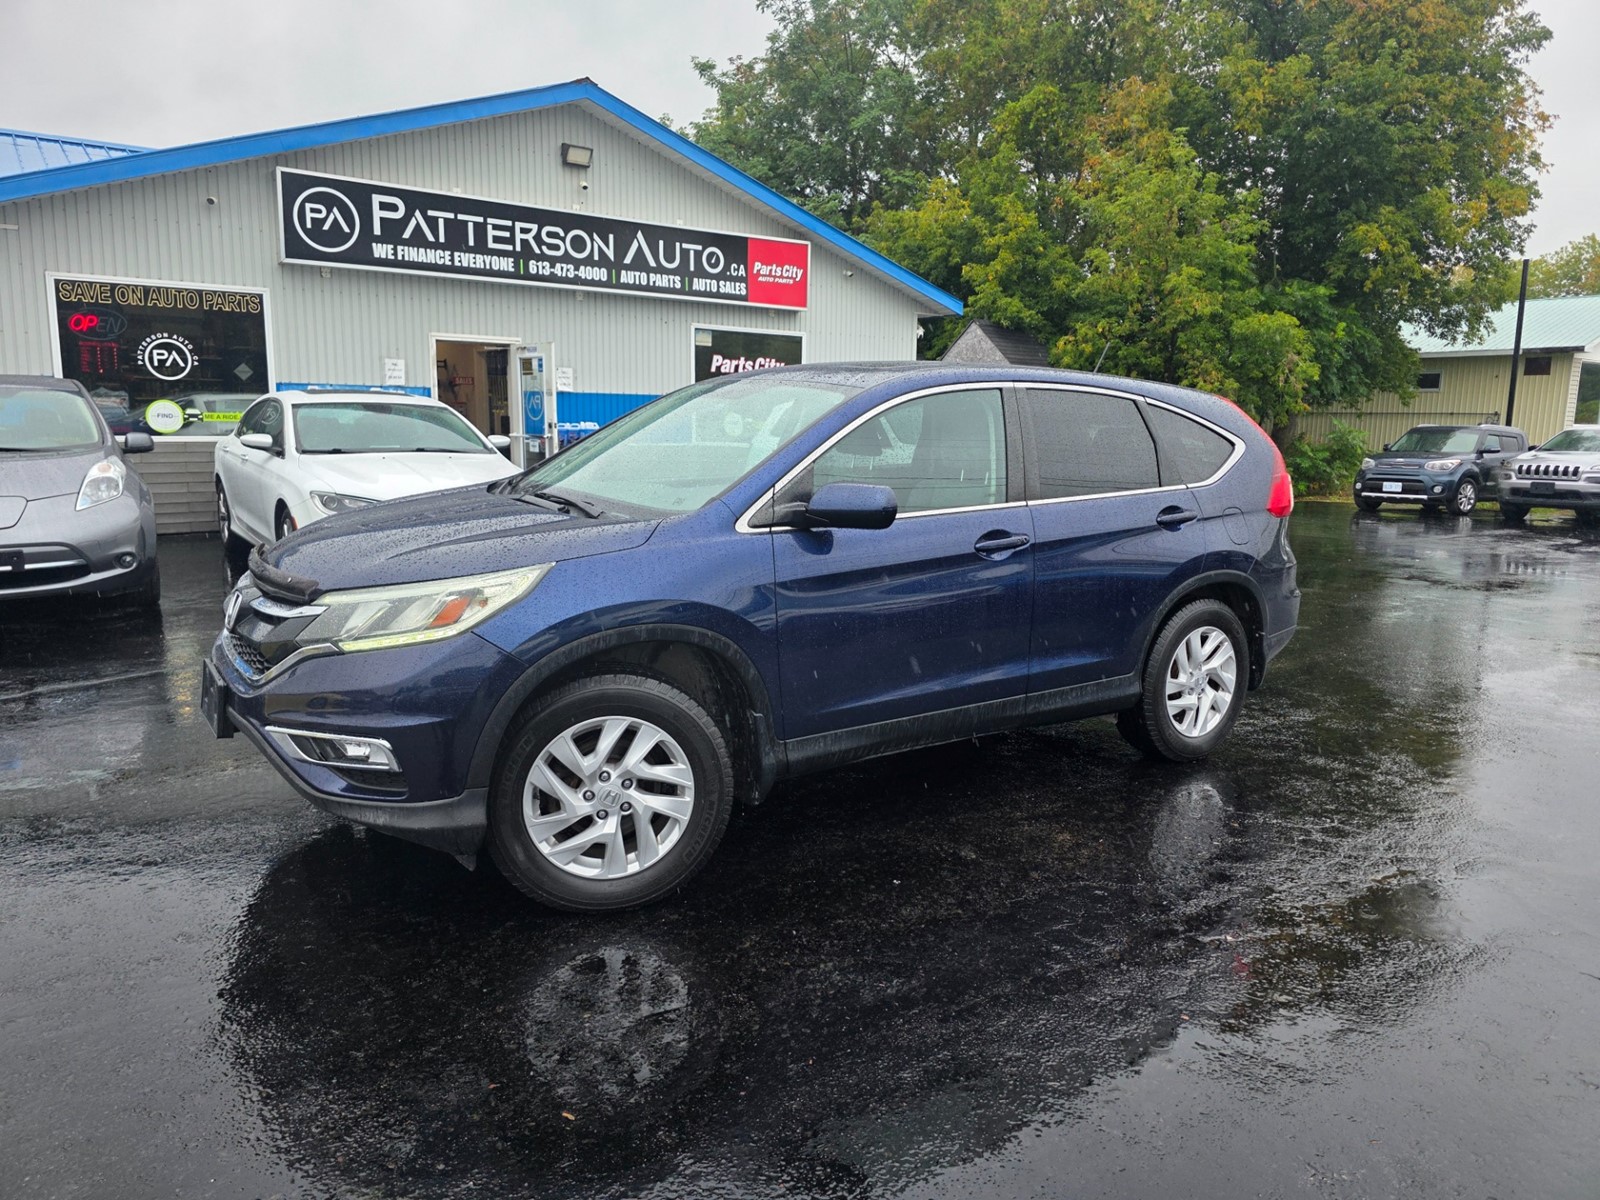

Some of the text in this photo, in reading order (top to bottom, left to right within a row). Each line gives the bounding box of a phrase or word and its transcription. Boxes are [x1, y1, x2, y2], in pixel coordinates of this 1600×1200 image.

[305, 202, 350, 233] PA
[371, 193, 614, 262] PATTERSON
[623, 229, 725, 274] AUTO
[372, 242, 747, 295] WE FINANCE EVERYONE 613-473-4000 AUTO PARTS AUTO SALES
[59, 280, 261, 314] SAVE ON AUTO PARTS
[137, 332, 169, 365] PATTERSON
[172, 334, 193, 350] AUTO
[152, 349, 186, 367] PA
[684, 799, 716, 861] MICHELIN
